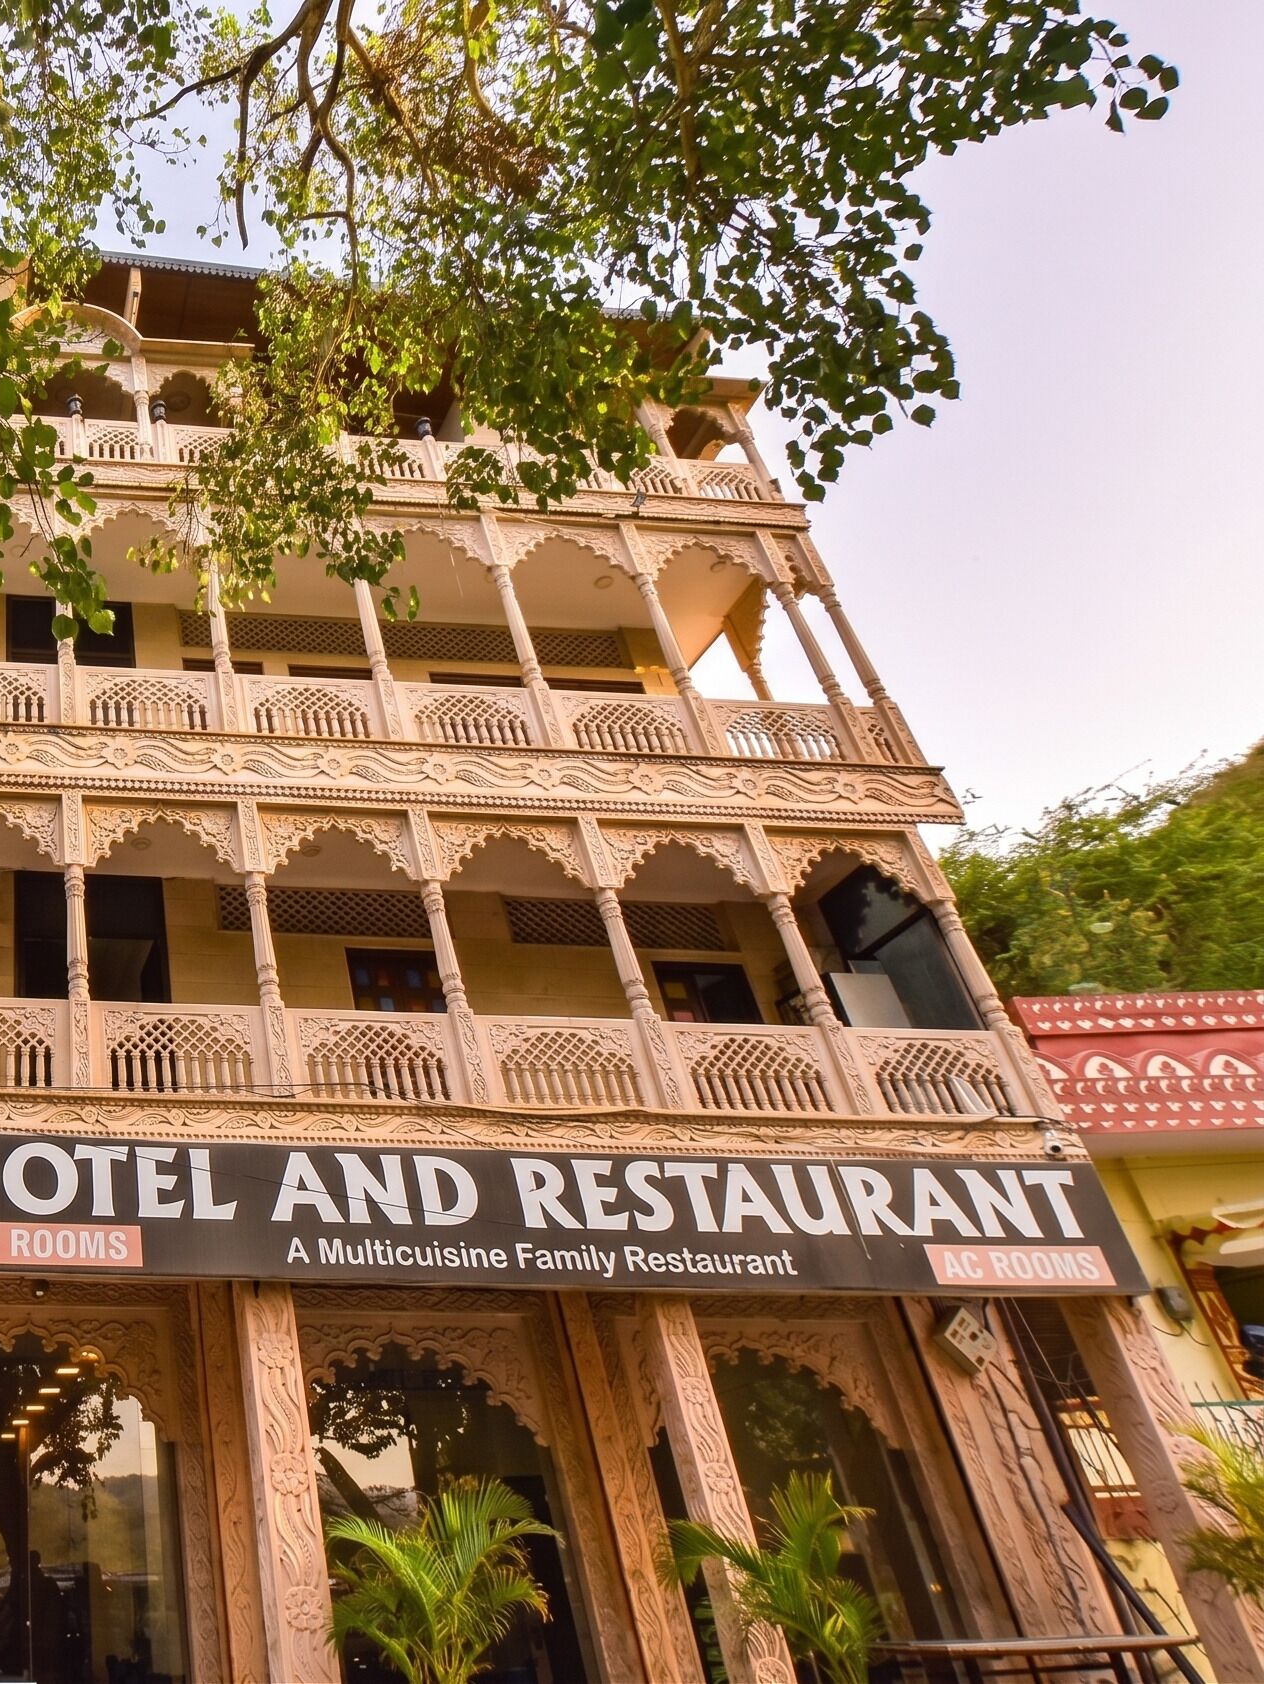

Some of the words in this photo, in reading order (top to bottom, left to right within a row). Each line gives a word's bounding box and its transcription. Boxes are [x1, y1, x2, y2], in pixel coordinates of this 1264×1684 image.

[271, 1152, 479, 1227] AND
[510, 1158, 1086, 1238] RESTAURANT
[10, 1231, 128, 1260] ROOMS
[287, 1237, 311, 1264] A
[321, 1238, 508, 1269] Multicuisine
[517, 1243, 616, 1279] Family
[626, 1246, 798, 1277] Restaurant
[943, 1251, 984, 1279] AC
[993, 1252, 1101, 1281] ROOMS
